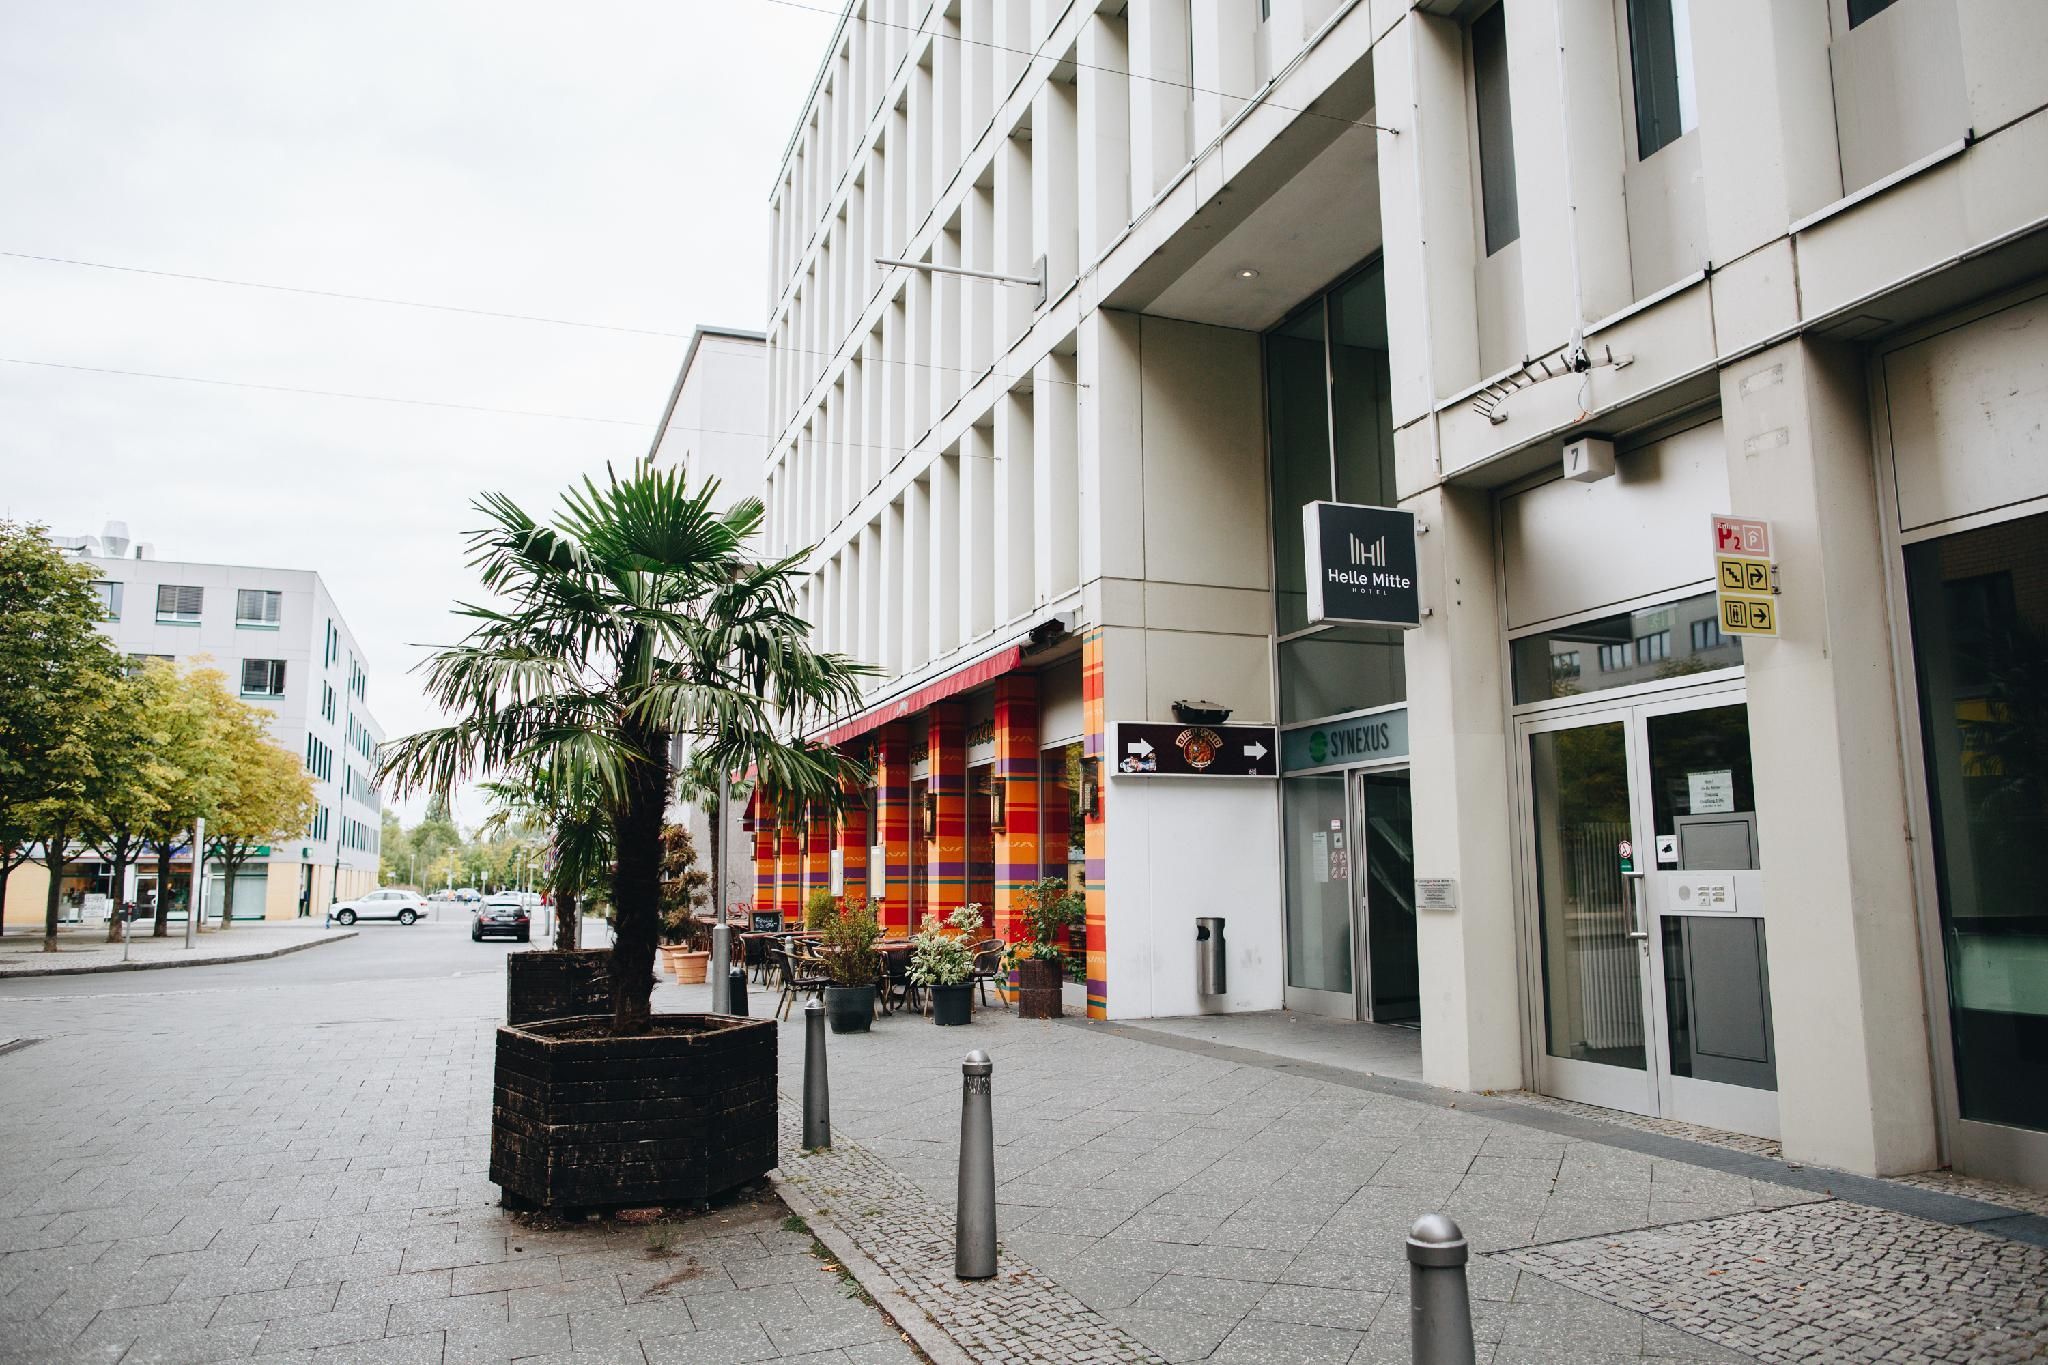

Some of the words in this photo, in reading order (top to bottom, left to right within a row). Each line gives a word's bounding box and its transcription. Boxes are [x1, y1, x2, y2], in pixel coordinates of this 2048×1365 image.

[1570, 447, 1579, 471] 7
[1328, 568, 1368, 585] Helle
[1373, 572, 1411, 589] Mitte
[1352, 587, 1388, 596] HOTEL
[1330, 722, 1390, 757] SYNEXUS
